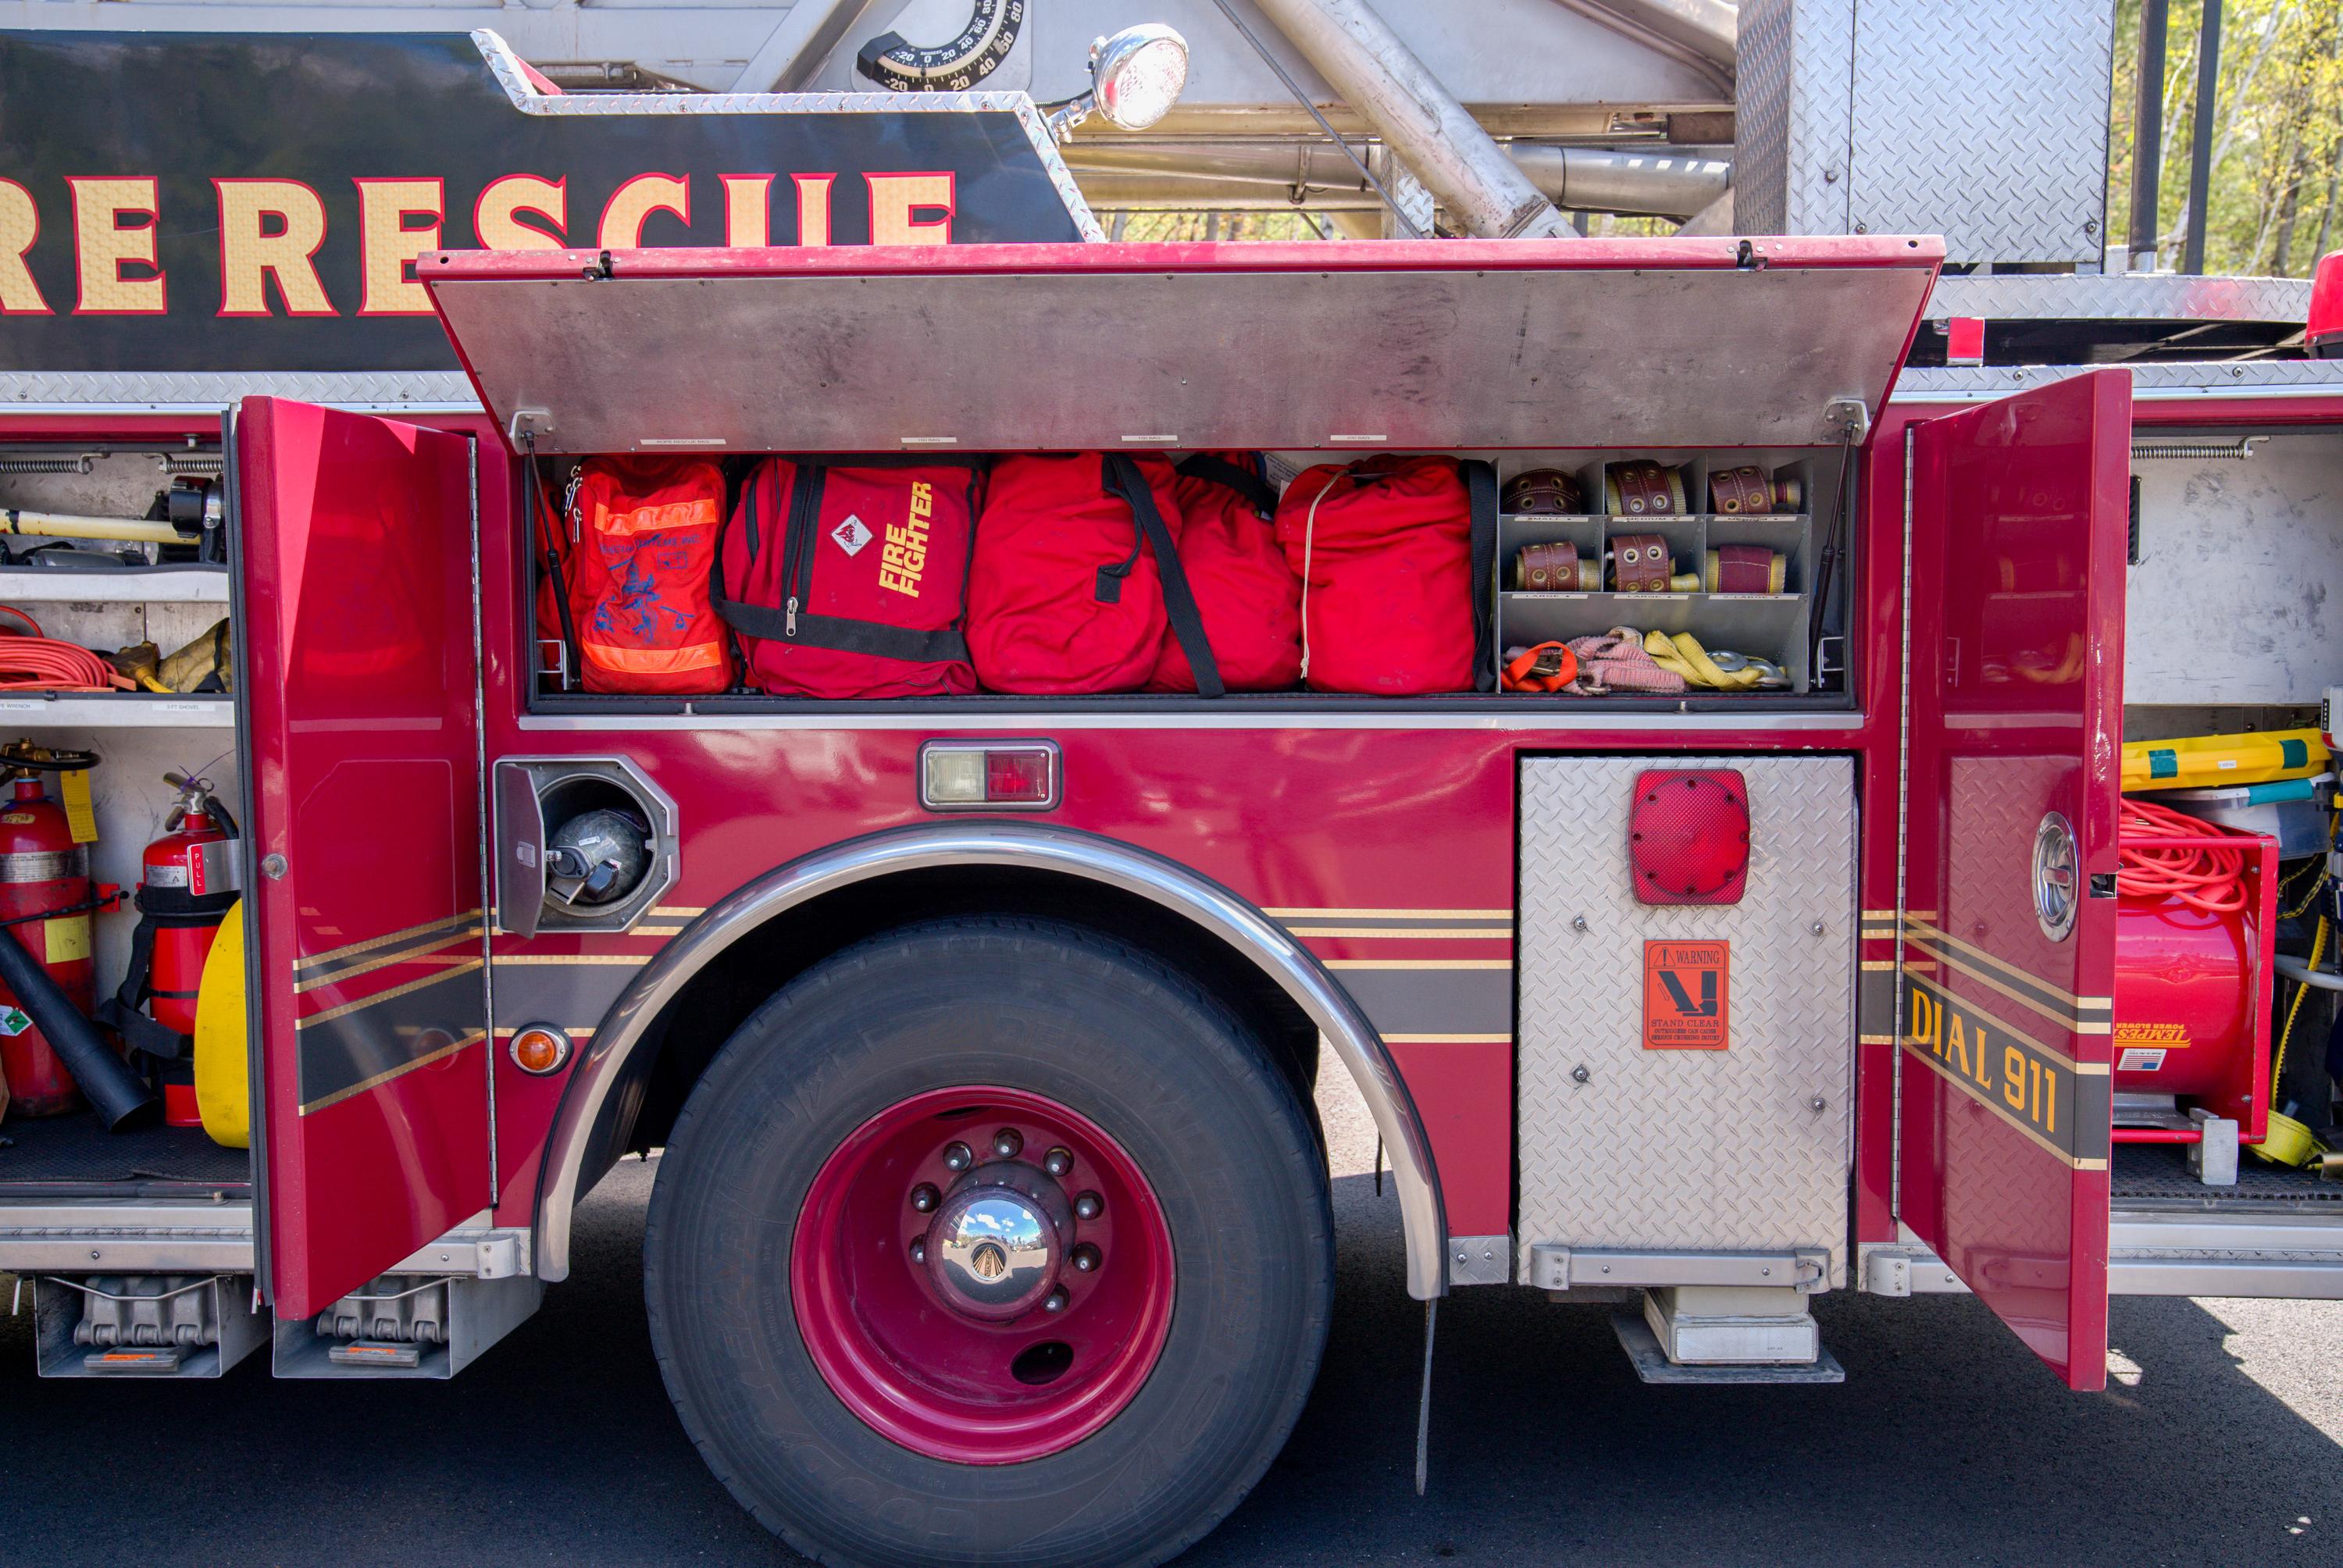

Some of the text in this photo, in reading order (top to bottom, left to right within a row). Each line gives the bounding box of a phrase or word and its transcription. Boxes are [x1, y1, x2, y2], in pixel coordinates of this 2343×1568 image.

[1011, 1, 1022, 23] 80
[973, 19, 986, 34] 60
[961, 37, 974, 50] 40
[896, 51, 915, 62] -20
[941, 48, 956, 60] 20
[979, 57, 996, 77] 40
[884, 78, 908, 91] -20
[950, 75, 970, 91] 20
[898, 481, 933, 598] FIGHTER
[879, 522, 907, 592] FIRE
[1676, 950, 1720, 964] WARNING
[1651, 1019, 1720, 1028] STAND CLEAR
[1911, 987, 2056, 1133] DIAL 911
